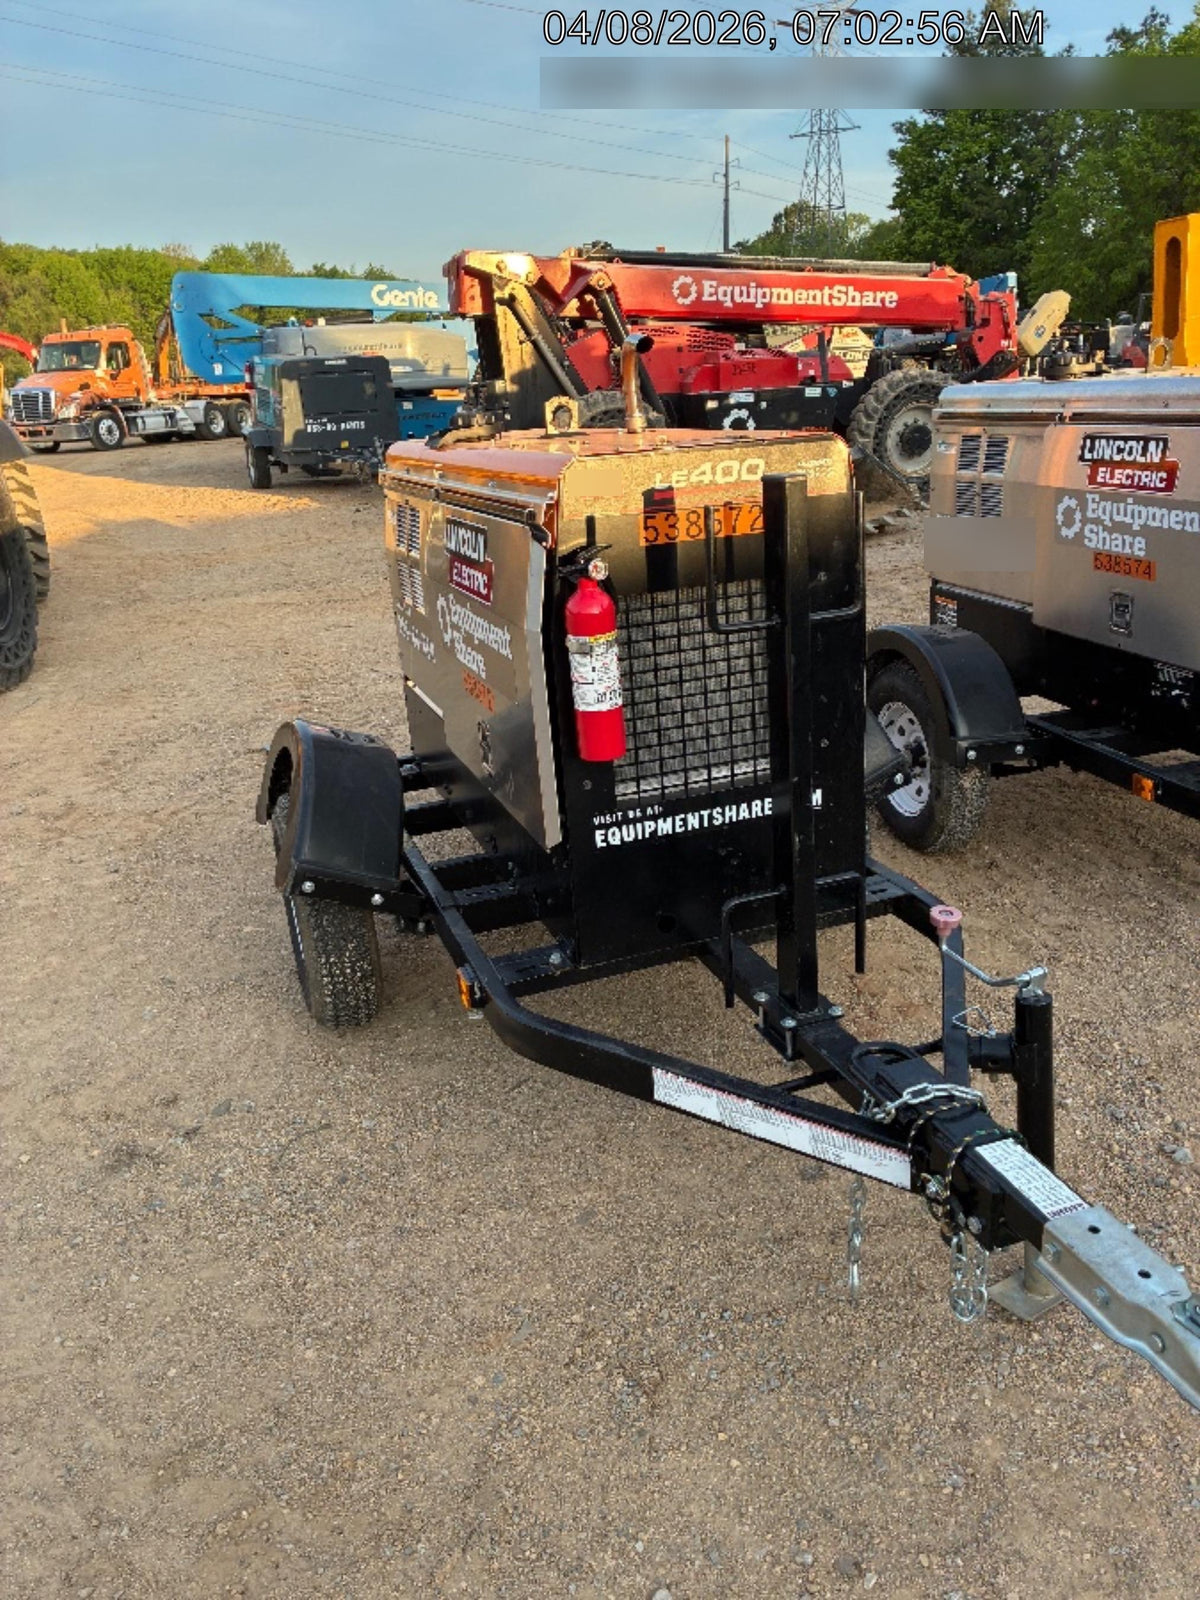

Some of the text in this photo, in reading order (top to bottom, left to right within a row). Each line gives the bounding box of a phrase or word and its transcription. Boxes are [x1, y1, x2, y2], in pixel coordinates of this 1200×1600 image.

[371, 284, 440, 308] Genie
[702, 280, 898, 308] EquipmentShare
[1083, 438, 1164, 463] LINCOLN
[655, 458, 766, 488] LE400
[1096, 467, 1167, 488] ELECTRIC
[643, 503, 765, 543] 538572
[1086, 493, 1200, 533] Equipmen
[446, 523, 485, 563] LINCOLN
[1084, 523, 1146, 557] Share
[1093, 552, 1153, 580] 538574
[449, 593, 513, 660] Equipment
[593, 812, 623, 826] VISIT
